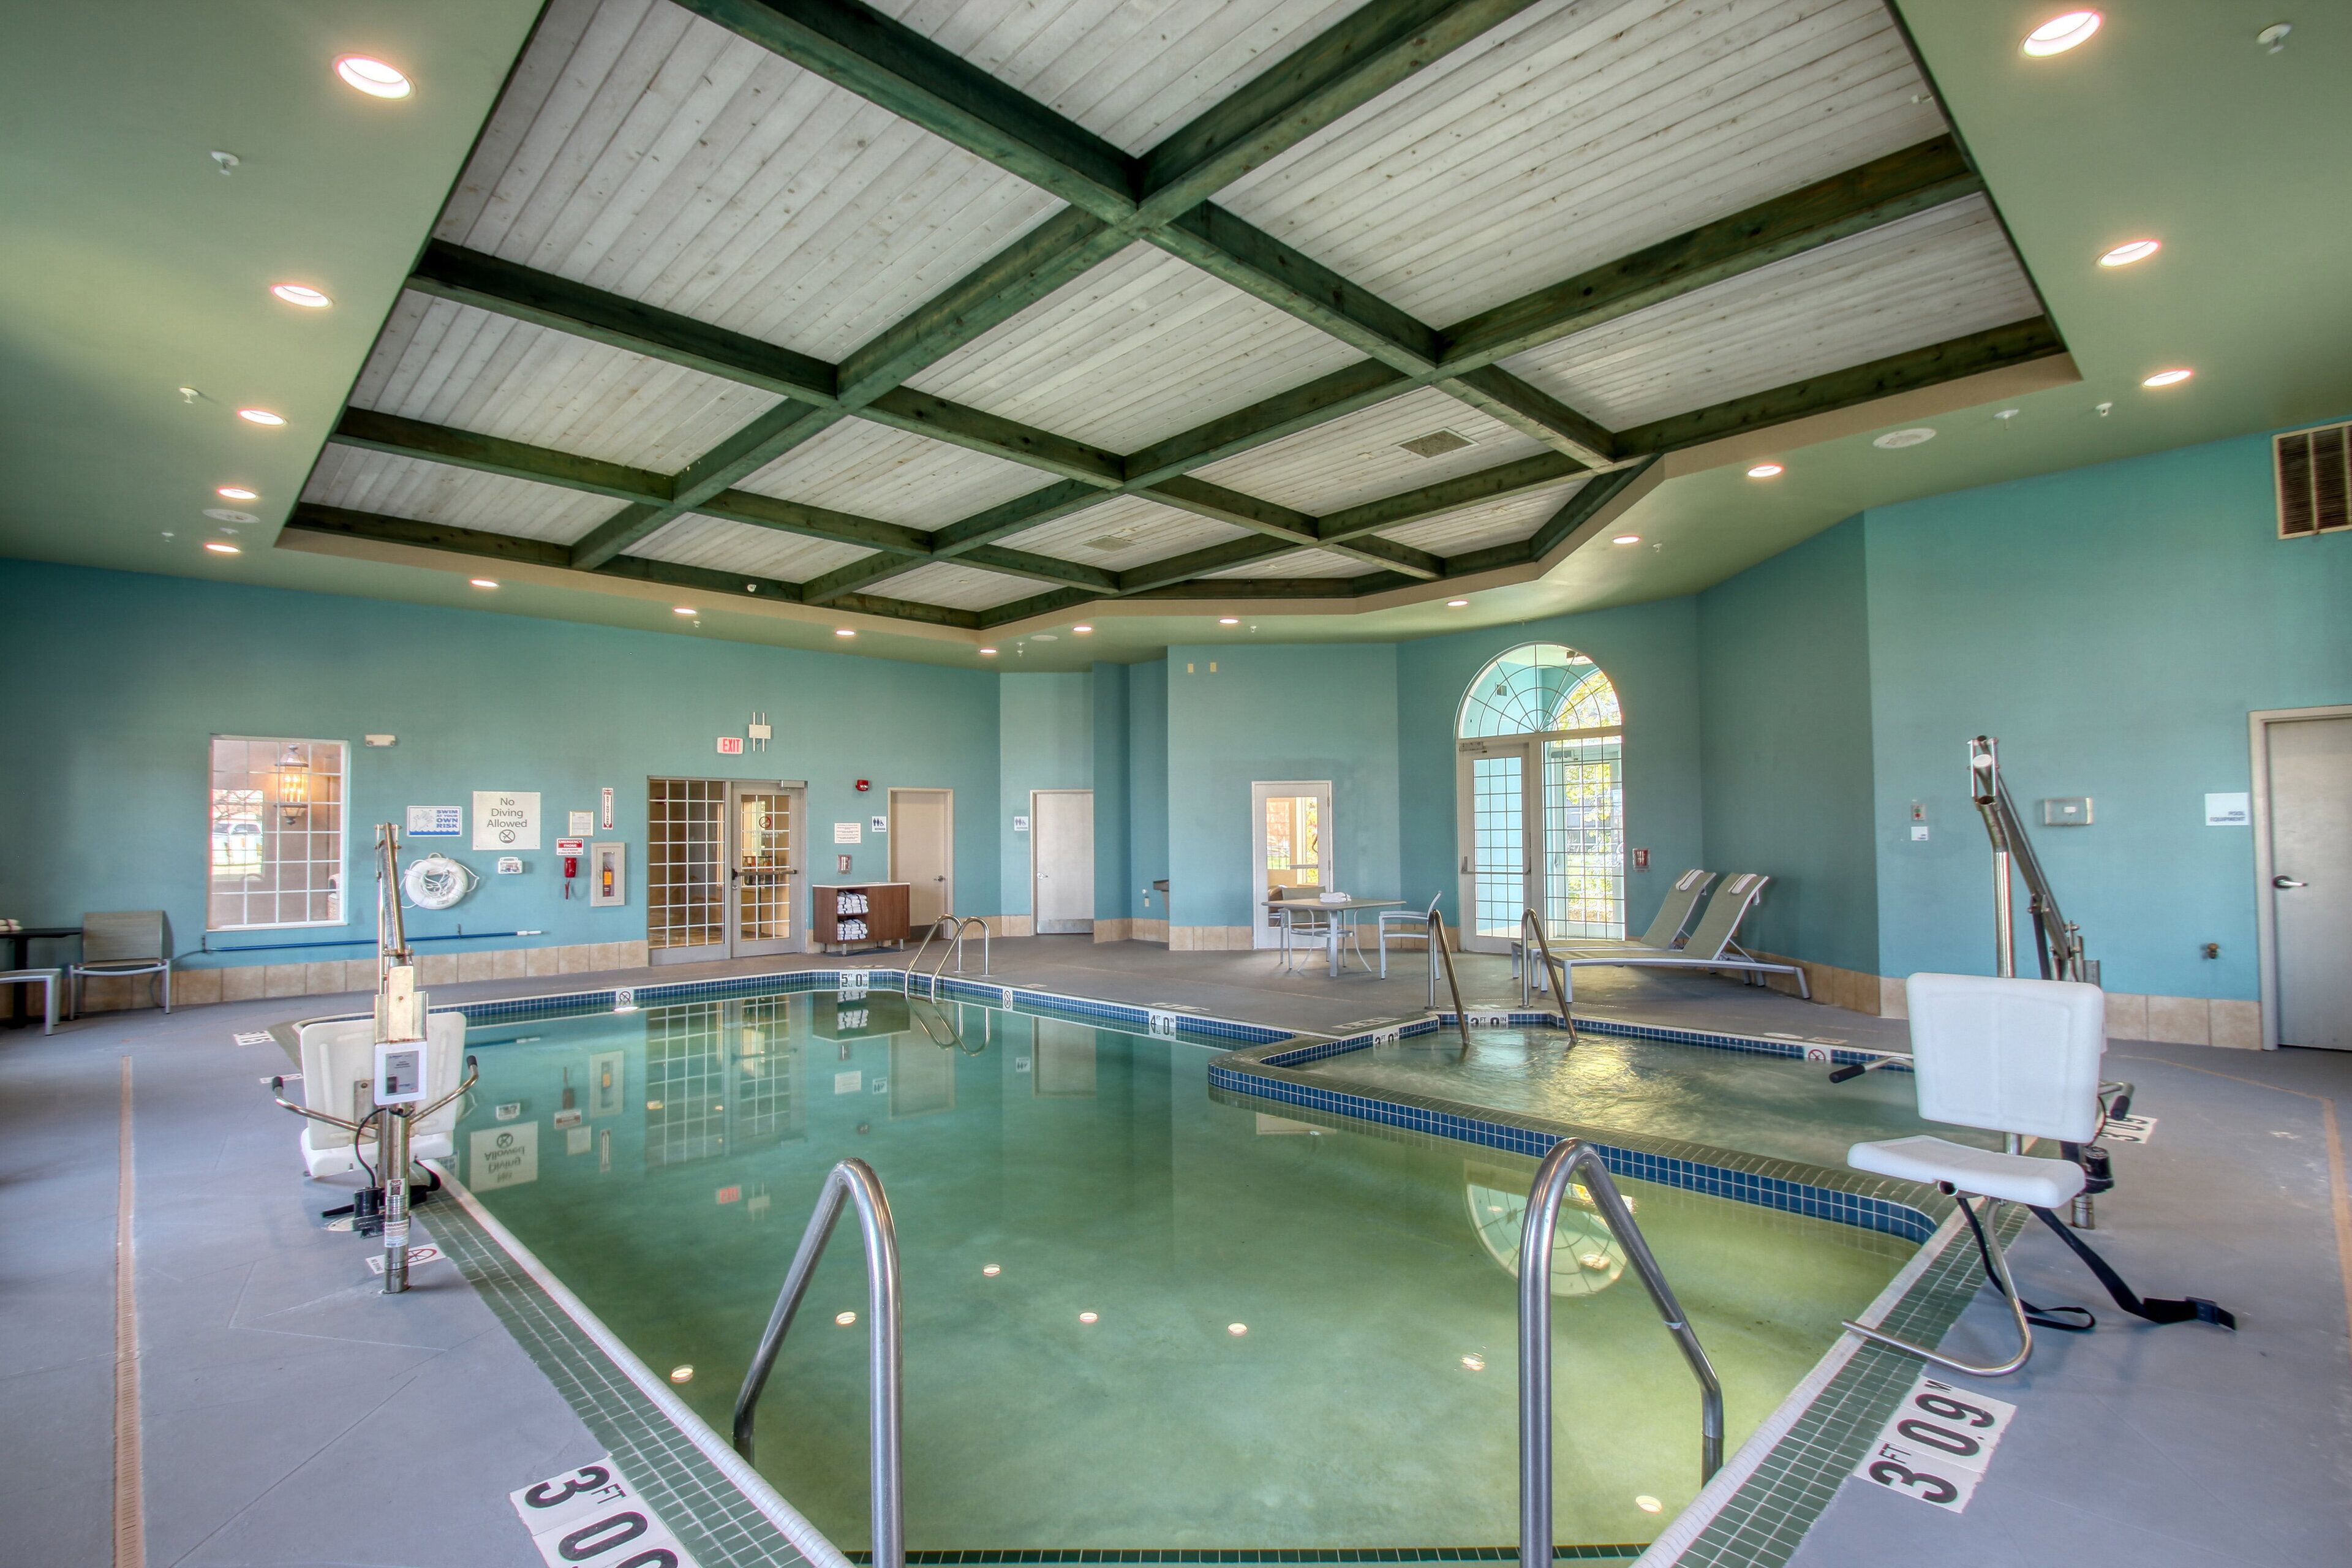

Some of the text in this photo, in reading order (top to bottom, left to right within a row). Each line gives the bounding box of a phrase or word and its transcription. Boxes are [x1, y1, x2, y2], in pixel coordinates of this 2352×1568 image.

[723, 739, 741, 752] EXIT
[500, 797, 515, 806] No
[491, 809, 523, 819] Diving
[487, 819, 527, 827] Allowed
[1924, 1379, 1953, 1393] M
[1878, 1443, 1912, 1464] FT
[525, 1466, 611, 1509] 3
[590, 1483, 627, 1505] FT
[1869, 1460, 1958, 1504] 3
